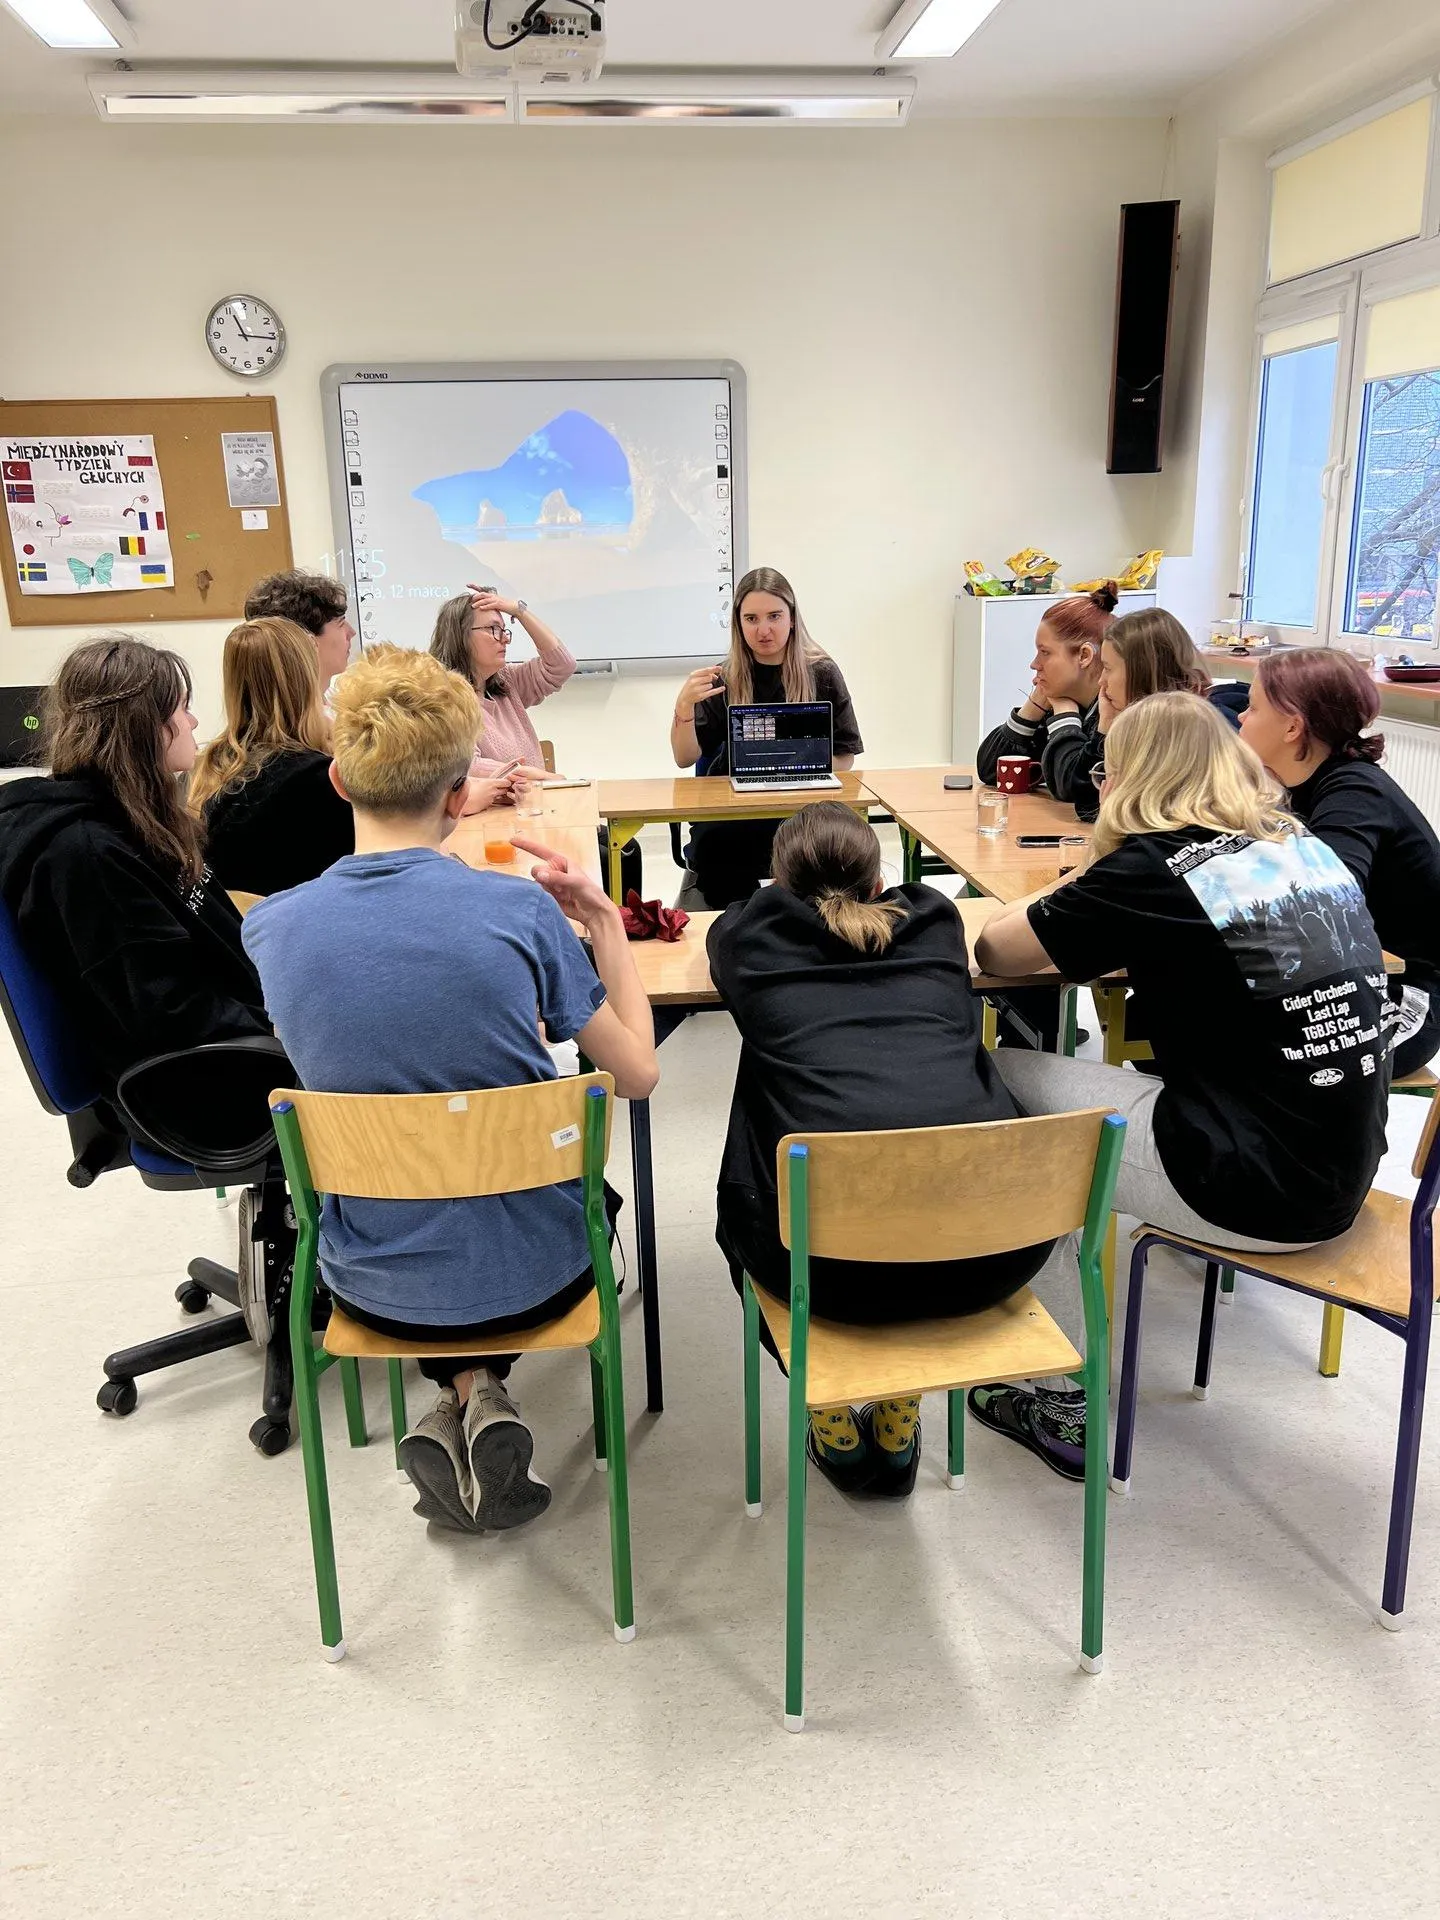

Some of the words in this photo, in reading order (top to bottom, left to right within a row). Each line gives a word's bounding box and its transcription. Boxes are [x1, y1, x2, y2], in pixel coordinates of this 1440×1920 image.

[225, 307, 232, 315] 11
[216, 317, 225, 325] 10
[263, 317, 271, 325] 2
[213, 331, 221, 339] 9
[219, 346, 228, 354] 8
[266, 346, 273, 354] 4
[230, 356, 237, 365] 7
[243, 360, 252, 369] 6
[257, 356, 265, 365] 5
[55, 457, 112, 471] TYDZIEŃ
[79, 471, 146, 485] GŁUCHYCH
[390, 584, 404, 598] 12
[408, 586, 451, 598] marca
[1165, 841, 1205, 867] NEW
[1171, 847, 1211, 876] NEW
[1282, 995, 1312, 1012] Cider
[1313, 981, 1358, 1003] Orchestra
[1306, 1005, 1332, 1023] Last
[1331, 1001, 1350, 1016] Lap
[1302, 1020, 1337, 1041] TGBJS
[1337, 1016, 1360, 1032] Crew
[1281, 1047, 1304, 1060] The
[1304, 1043, 1329, 1058] Flea
[1329, 1039, 1340, 1052] &
[1338, 1034, 1357, 1049] The
